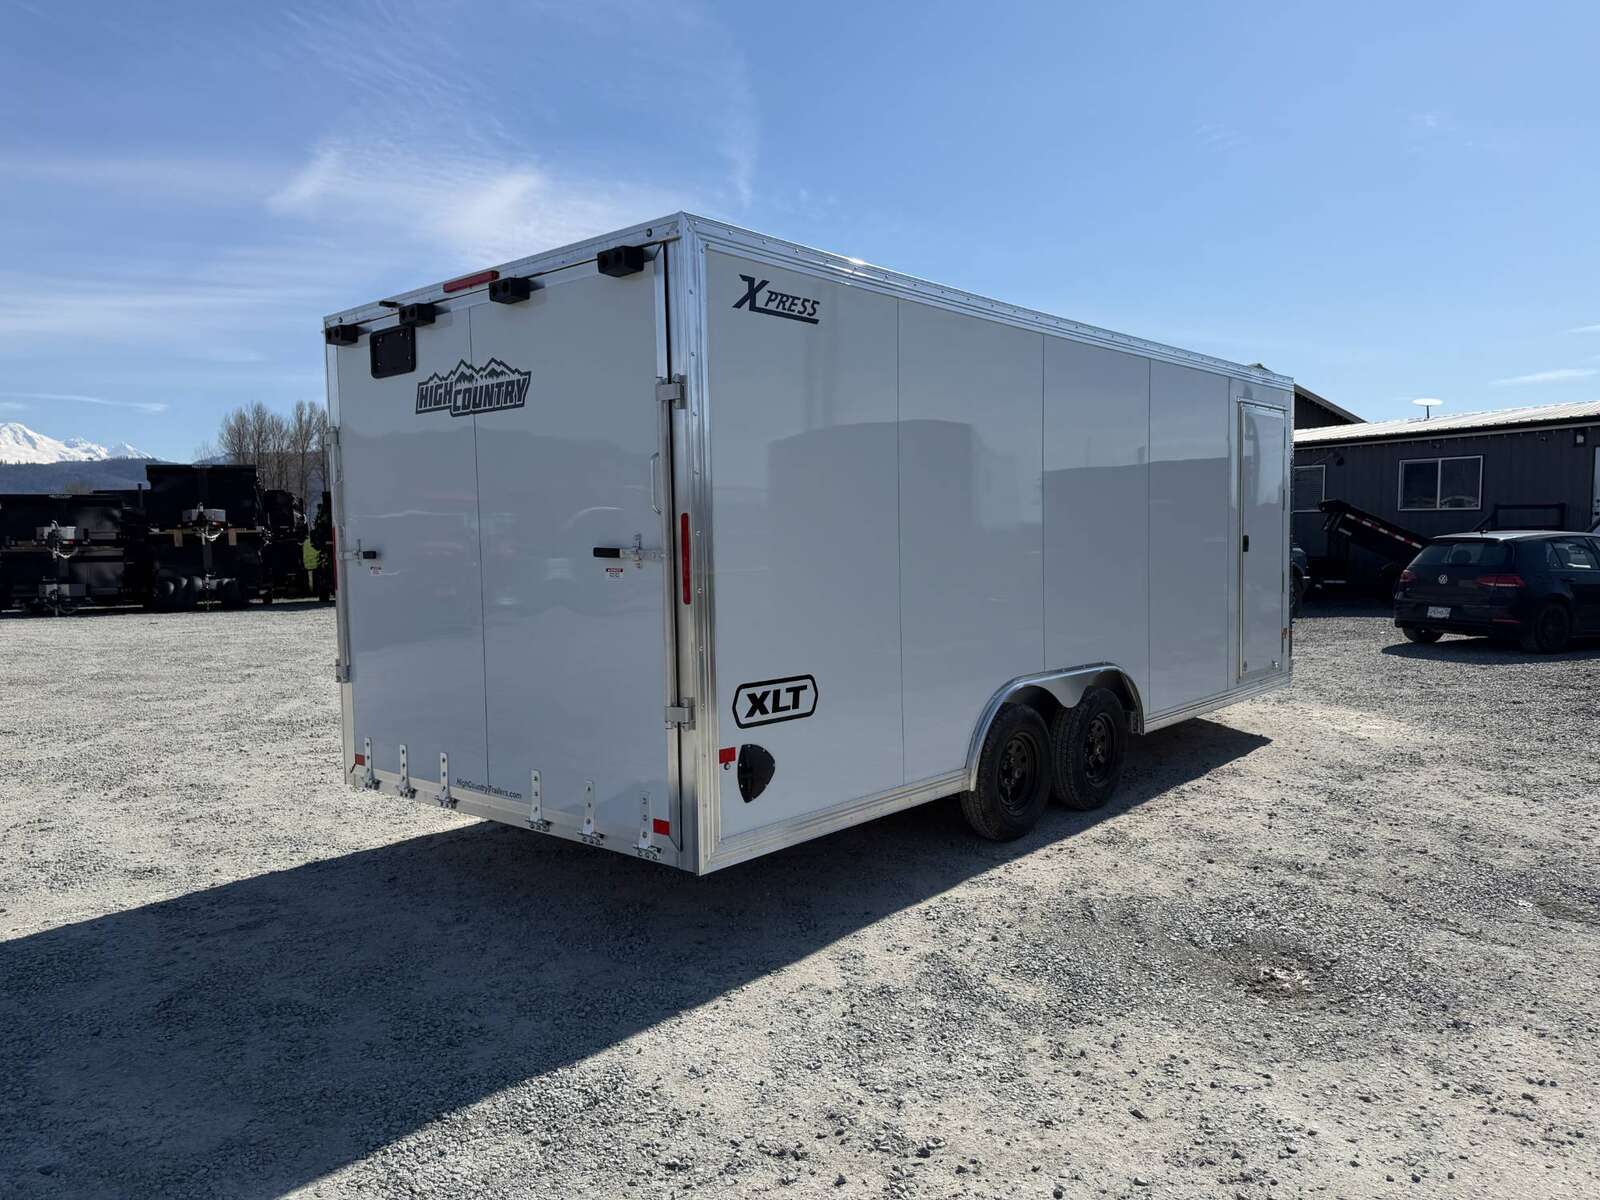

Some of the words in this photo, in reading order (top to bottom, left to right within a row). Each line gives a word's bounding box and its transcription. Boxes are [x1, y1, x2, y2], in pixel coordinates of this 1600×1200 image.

[419, 381, 453, 409] HIGH
[452, 377, 528, 412] COUNTRY
[744, 684, 808, 719] XLT
